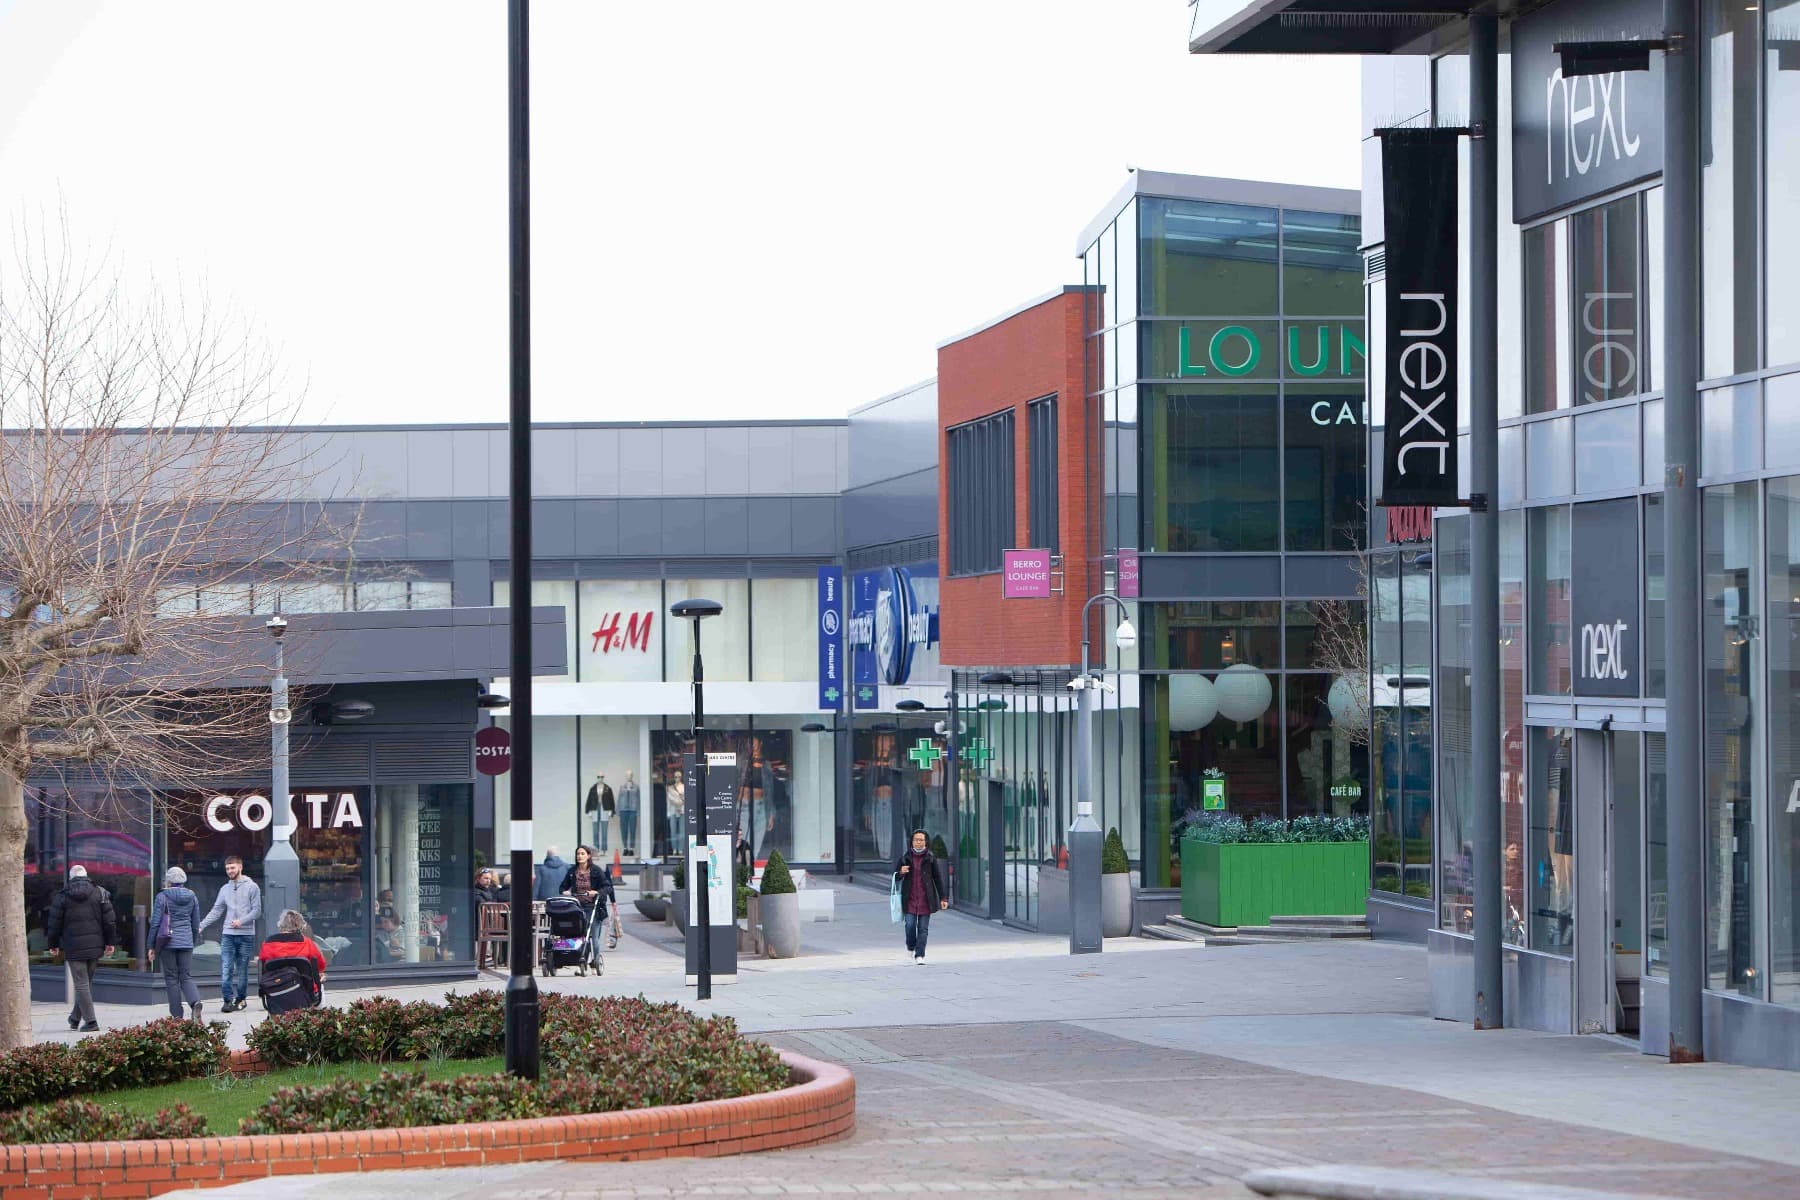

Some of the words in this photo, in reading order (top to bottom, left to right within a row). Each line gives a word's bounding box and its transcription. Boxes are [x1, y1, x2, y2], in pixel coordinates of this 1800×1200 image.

[1547, 32, 1640, 184] next
[1398, 293, 1449, 476] next
[1310, 401, 1368, 425] CA
[1008, 572, 1047, 580] LOUNGE
[1013, 560, 1042, 569] BERRO
[592, 611, 654, 653] H&M
[827, 643, 836, 679] pharmacy
[1581, 618, 1628, 680] next
[1330, 784, 1347, 797] CAFÉ
[1348, 786, 1362, 797] BAR
[421, 839, 441, 849] COLD
